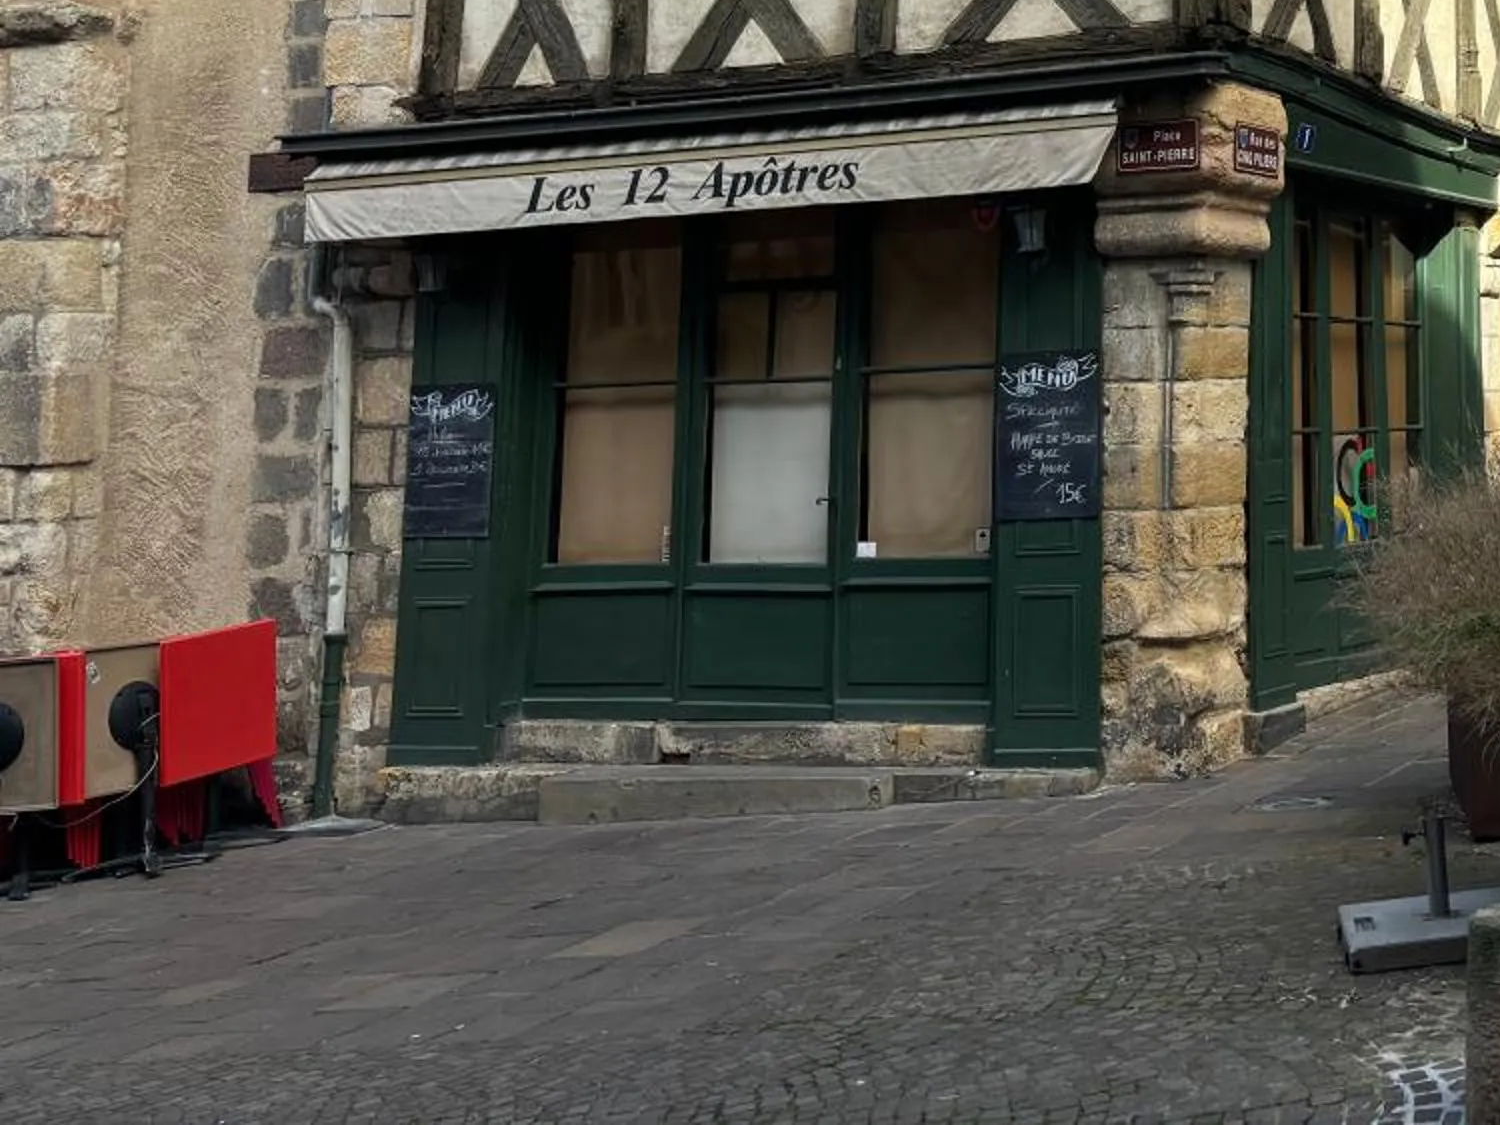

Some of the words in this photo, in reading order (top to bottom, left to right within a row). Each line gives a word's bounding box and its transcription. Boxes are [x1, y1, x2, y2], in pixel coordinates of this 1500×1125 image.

[1153, 130, 1182, 143] Place
[1122, 146, 1195, 164] SAINT-PIERRE
[523, 176, 595, 214] Les
[622, 166, 670, 206] 12
[690, 156, 860, 208] Apôtres
[1021, 366, 1075, 388] MENU
[1056, 482, 1088, 504] 15€
